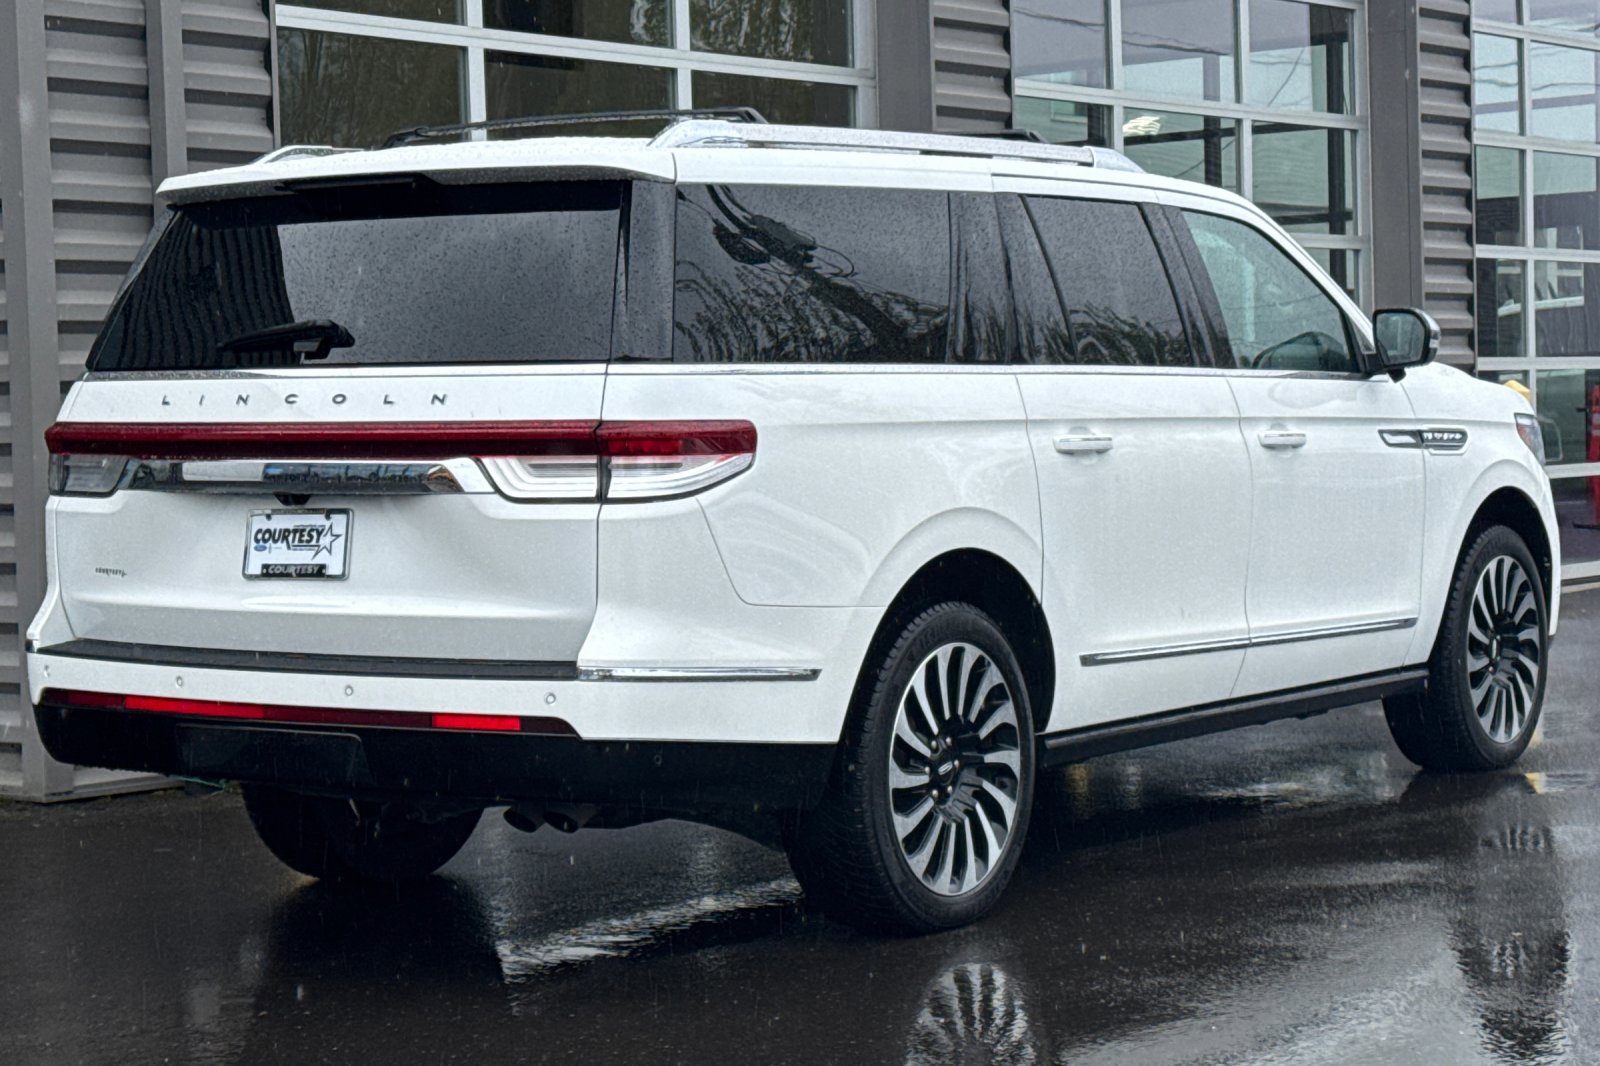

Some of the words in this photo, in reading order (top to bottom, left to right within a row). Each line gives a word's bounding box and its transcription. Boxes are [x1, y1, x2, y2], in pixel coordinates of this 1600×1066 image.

[161, 393, 448, 406] LINCOLN
[253, 528, 325, 551] COURTESY
[267, 564, 319, 577] COURTESY
